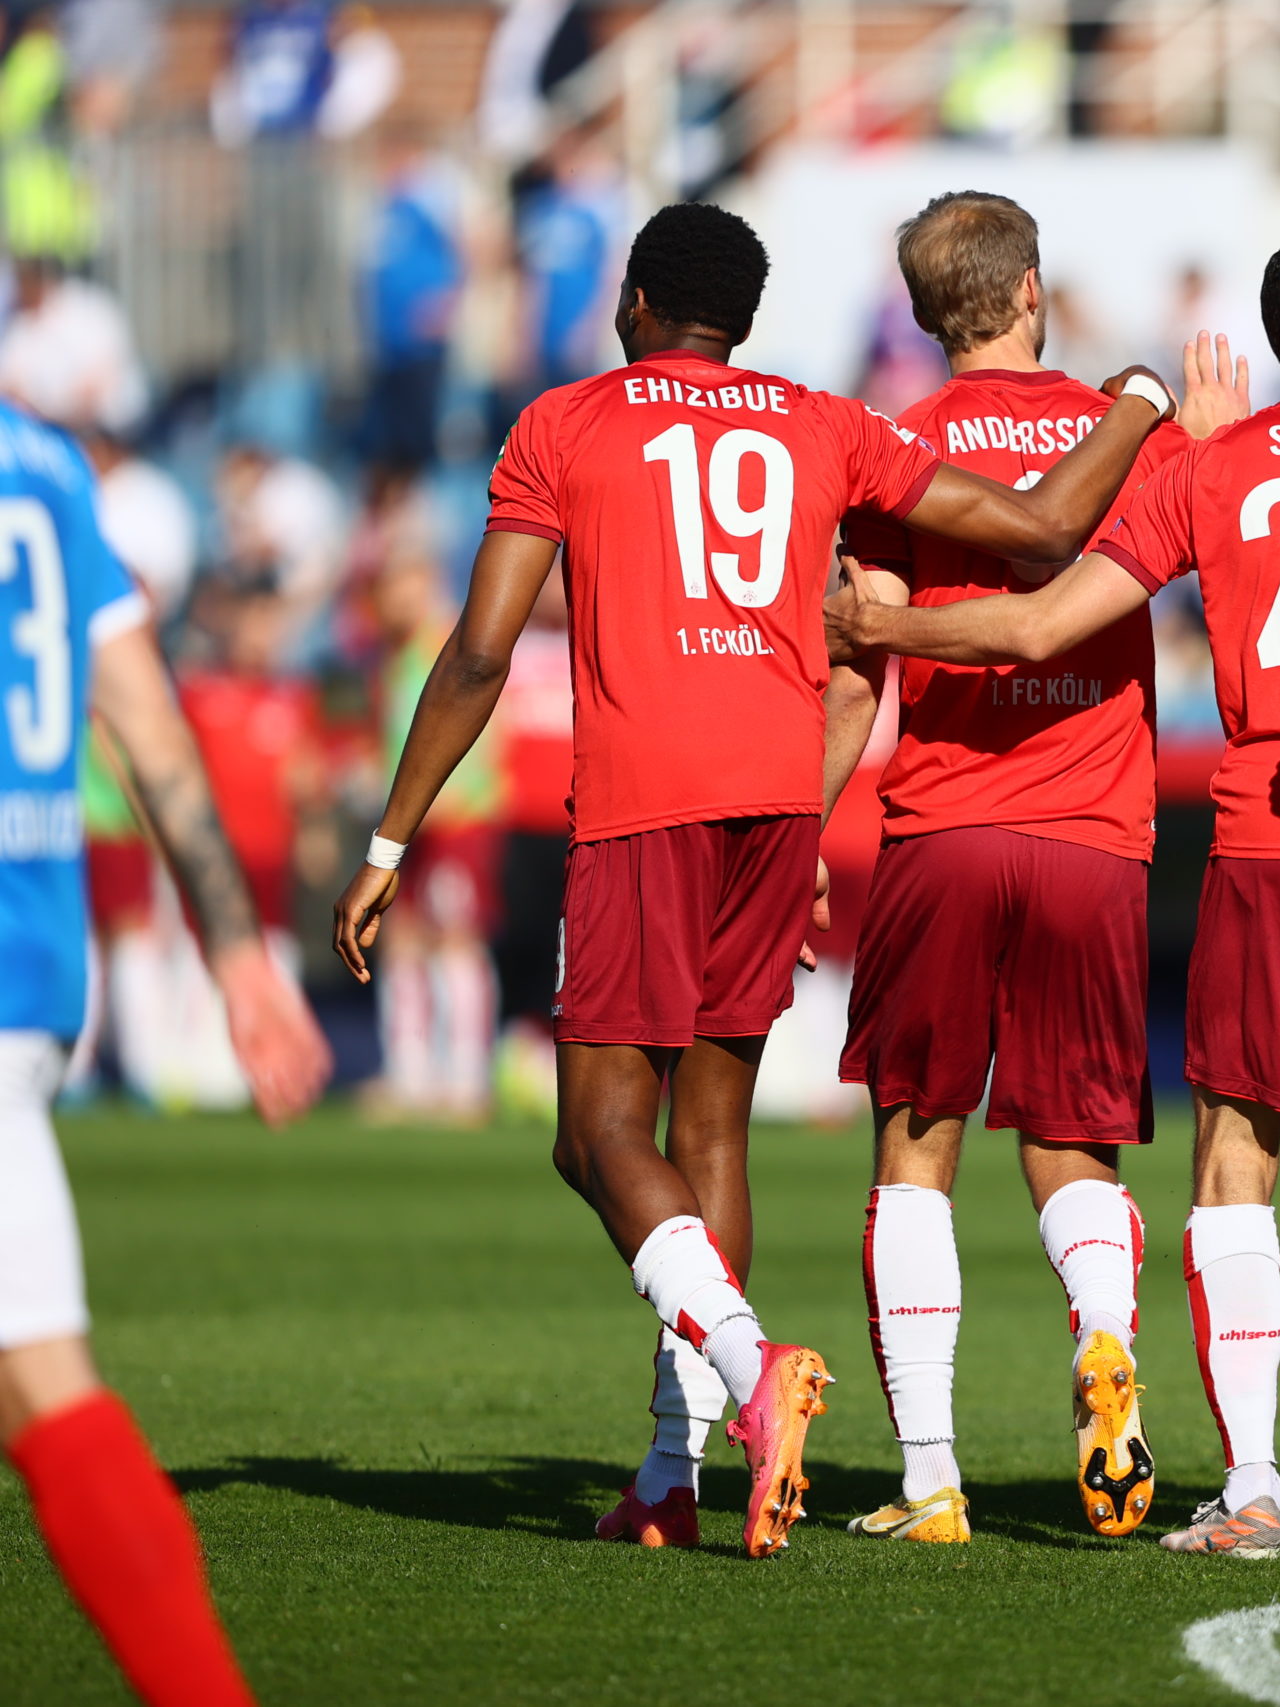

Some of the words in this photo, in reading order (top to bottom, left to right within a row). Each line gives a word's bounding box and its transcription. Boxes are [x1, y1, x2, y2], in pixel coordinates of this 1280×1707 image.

[624, 376, 789, 415] EHIZIBUE
[946, 414, 1104, 455] ANDERSSO
[642, 422, 794, 608] 19
[0, 497, 71, 773] 3
[1012, 678, 1041, 705] FC
[1046, 673, 1102, 706] KÖLN
